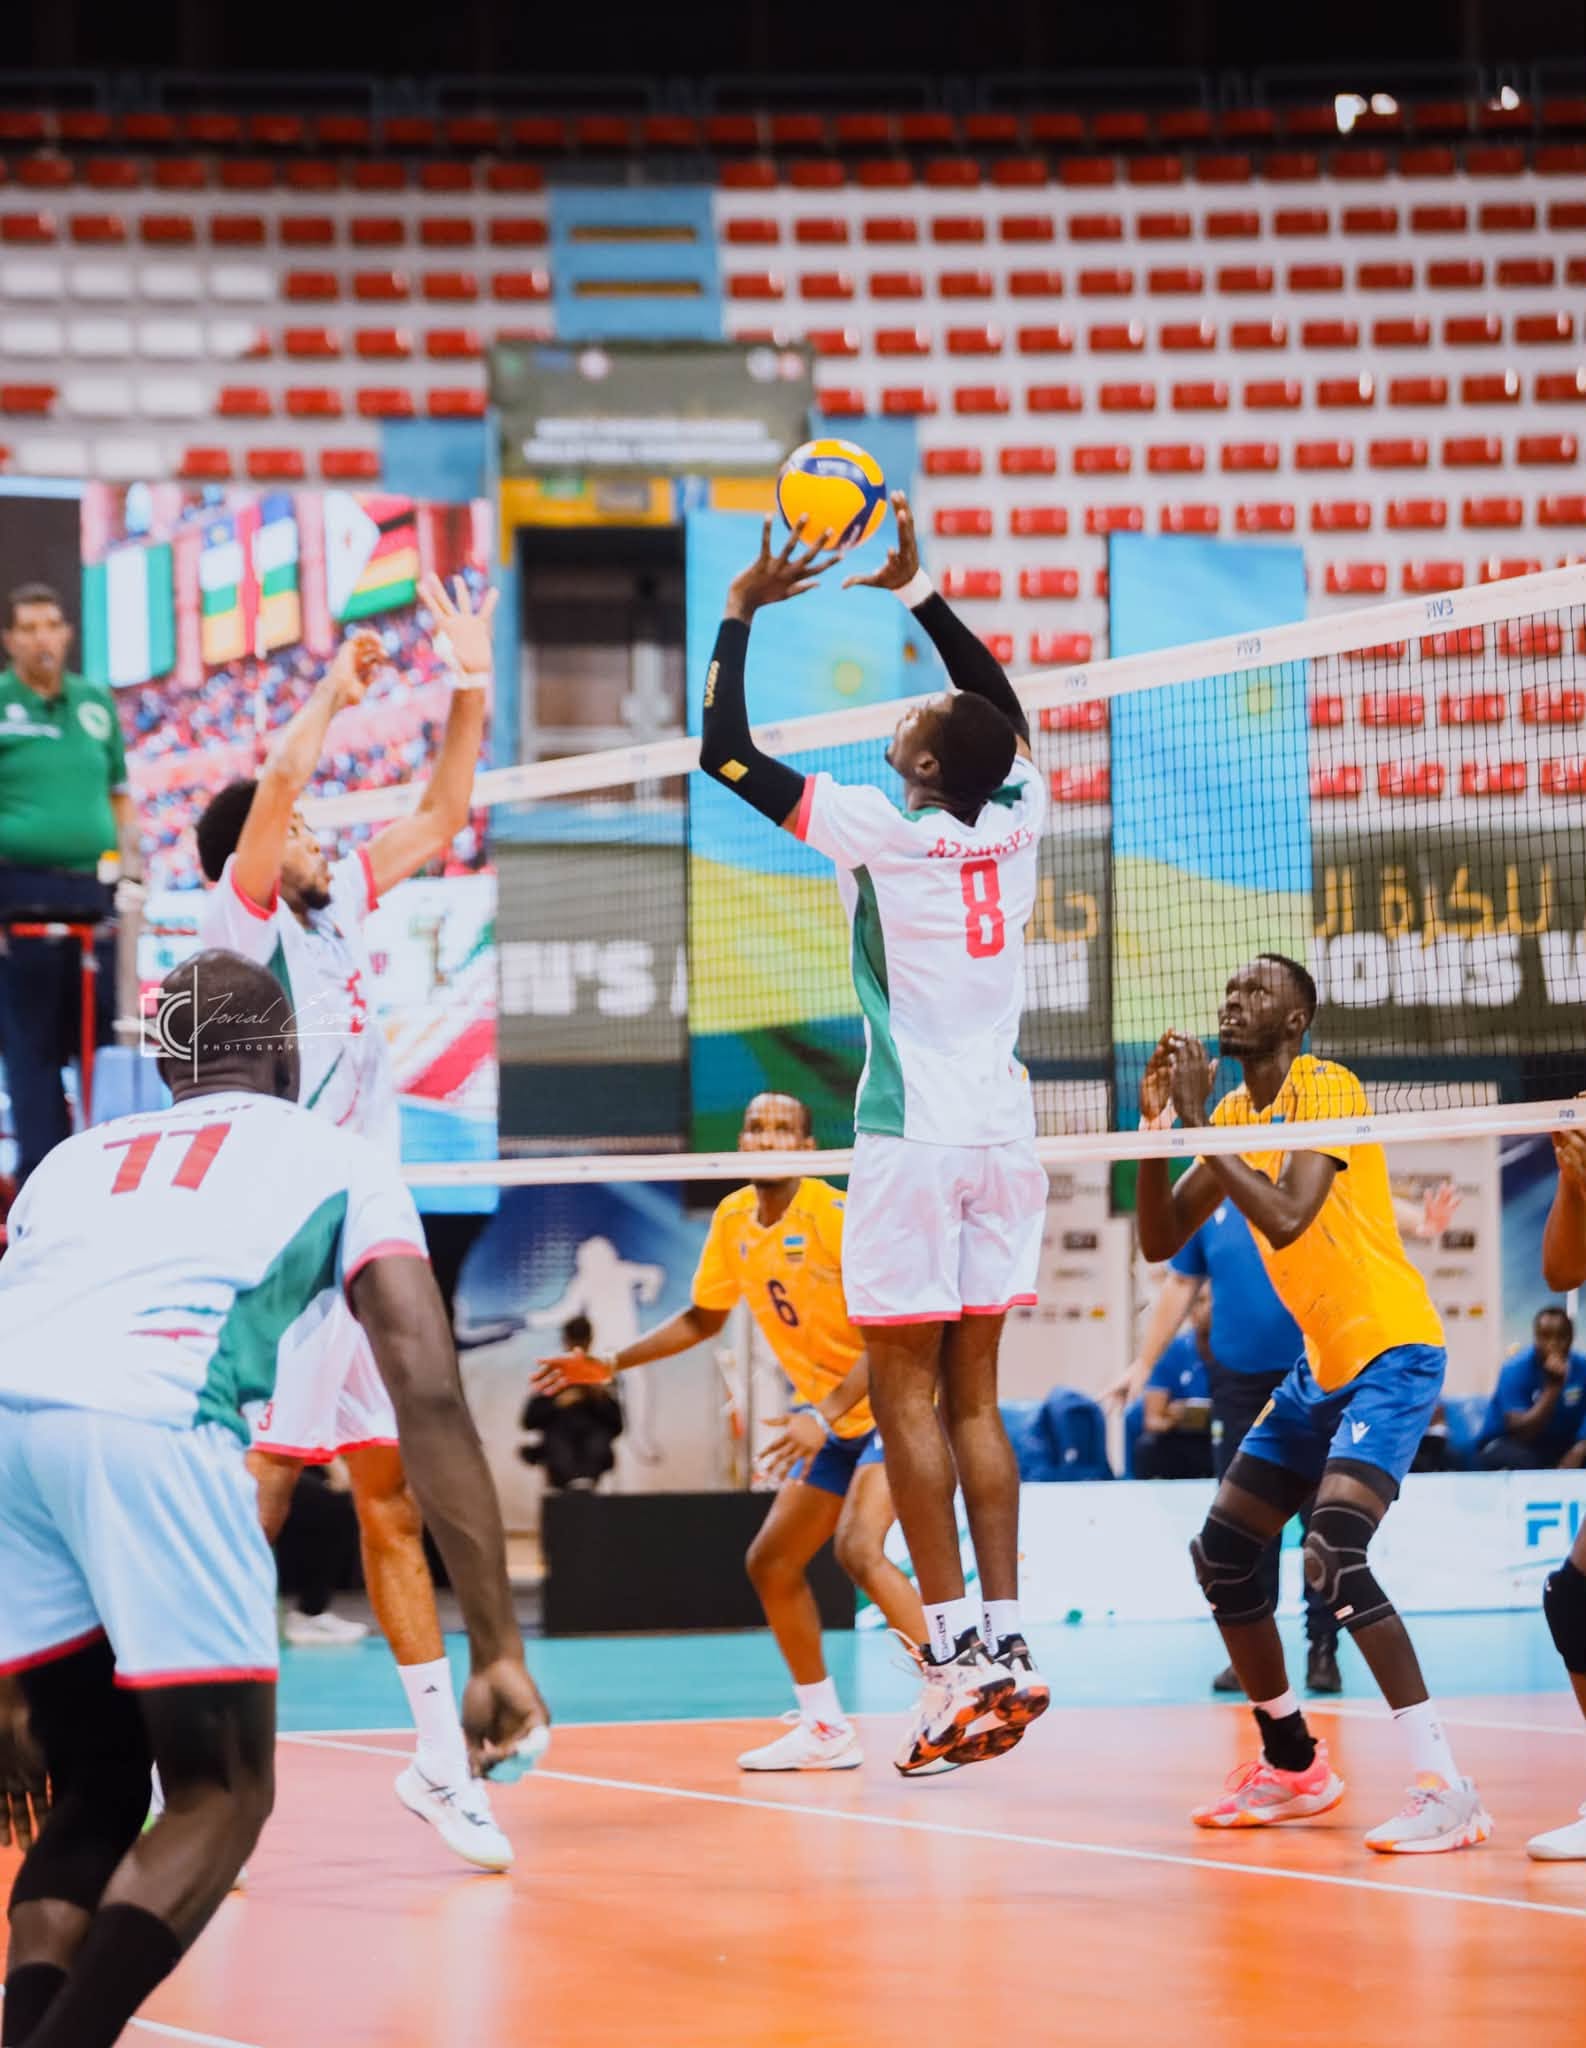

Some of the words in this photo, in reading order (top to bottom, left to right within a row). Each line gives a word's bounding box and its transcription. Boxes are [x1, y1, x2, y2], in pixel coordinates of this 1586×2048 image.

[960, 858, 1006, 958] 8
[103, 1121, 232, 1195] 77
[767, 1279, 799, 1327] 6
